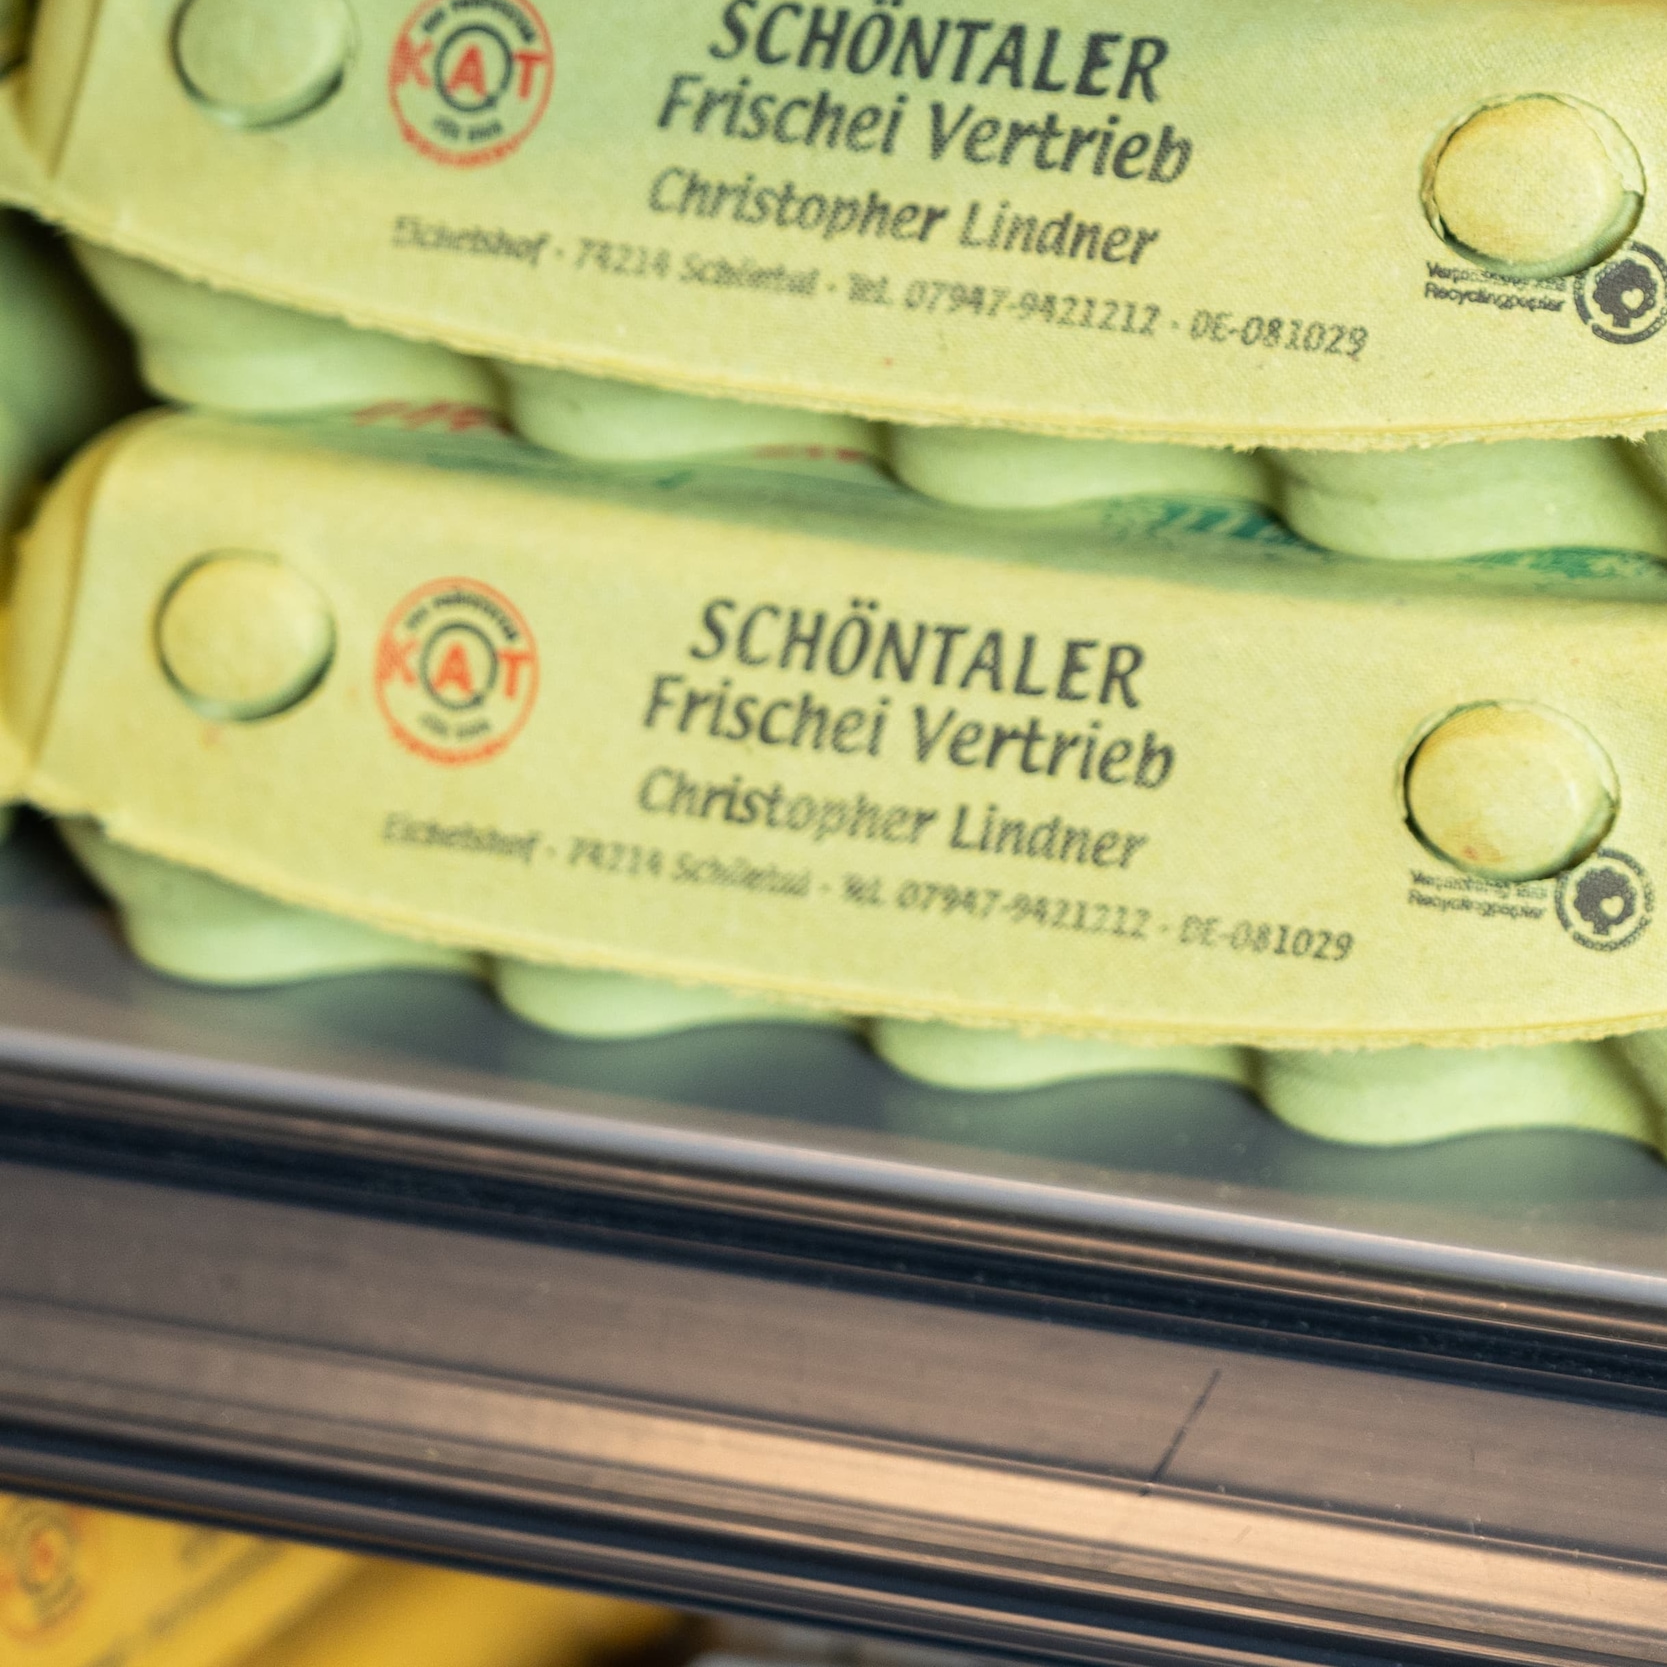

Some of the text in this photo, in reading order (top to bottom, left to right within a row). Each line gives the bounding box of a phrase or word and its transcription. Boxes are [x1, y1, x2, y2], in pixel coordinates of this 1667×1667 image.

[655, 73, 1194, 186] Frischei Vertrieb
[647, 164, 1163, 268] Christopher Lindner
[1189, 307, 1370, 365] DE-081029
[689, 597, 1146, 710] SCHÖNTALER
[642, 672, 1179, 792] Frischei Vertrieb
[636, 764, 1152, 872] Christopher Lindner
